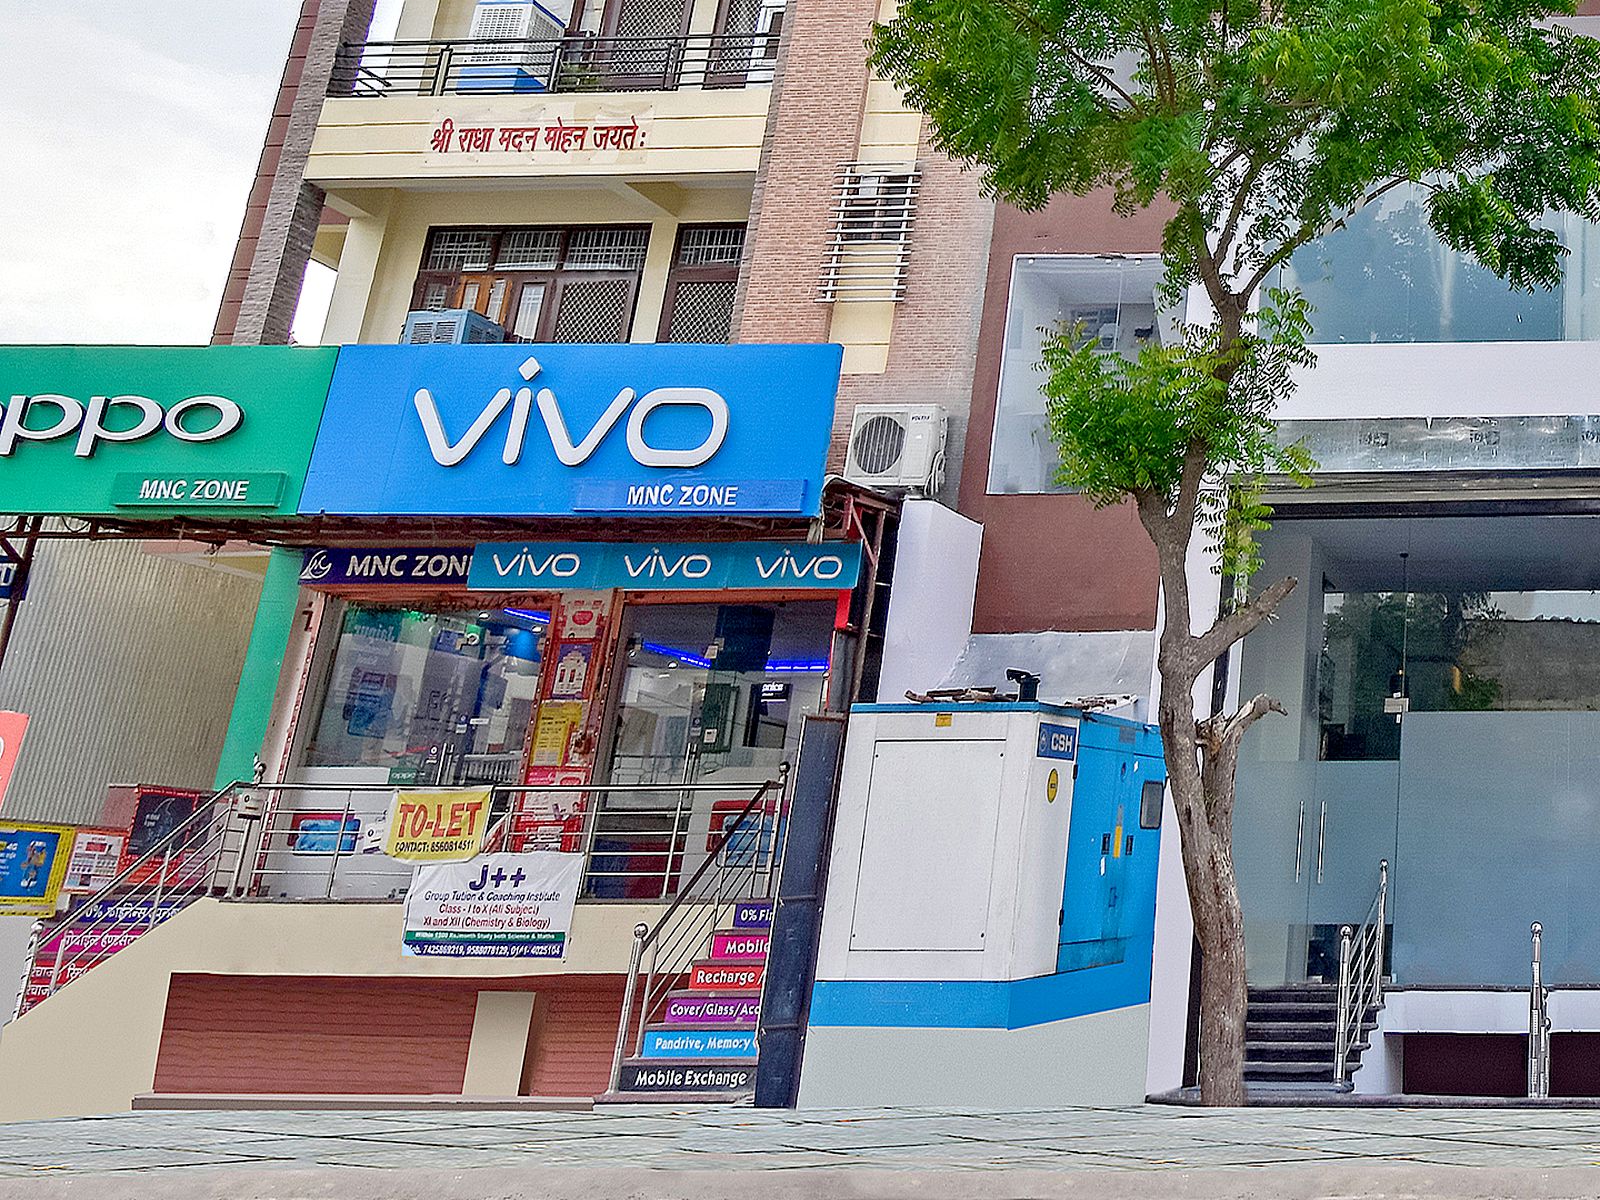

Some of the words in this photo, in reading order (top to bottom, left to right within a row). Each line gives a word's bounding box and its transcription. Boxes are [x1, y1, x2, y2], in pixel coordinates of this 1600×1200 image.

[430, 118, 455, 154] श्री
[458, 127, 495, 152] राधा
[499, 127, 540, 152] मदन
[543, 116, 589, 154] मोहन
[413, 356, 730, 468] vivo
[0, 393, 244, 459] ppo
[139, 478, 186, 500] MNC
[190, 479, 250, 501] ZONE
[626, 485, 674, 506] MNC
[678, 485, 739, 506] ZONE
[345, 555, 407, 577] MNC
[492, 547, 581, 577] vivo
[624, 547, 712, 578] vivo
[755, 549, 843, 579] vivo
[398, 801, 483, 838] TO-LET
[395, 841, 429, 852] CONTACT:
[468, 864, 527, 891] J++
[424, 890, 450, 902] Group
[478, 891, 485, 901] &
[486, 891, 525, 903] Coaching
[526, 891, 561, 901] Institute
[439, 903, 462, 914] Class
[472, 904, 480, 914] to
[741, 909, 757, 921] 0%
[432, 917, 448, 927] and
[461, 917, 507, 929] (Chemistry
[507, 917, 514, 928] &
[515, 917, 551, 929] Biology)
[696, 969, 756, 986] Recharge
[655, 1037, 705, 1051] Pandrive,
[706, 1037, 751, 1051] Memory
[635, 1070, 683, 1087] Mobile
[684, 1070, 748, 1088] Exchange
